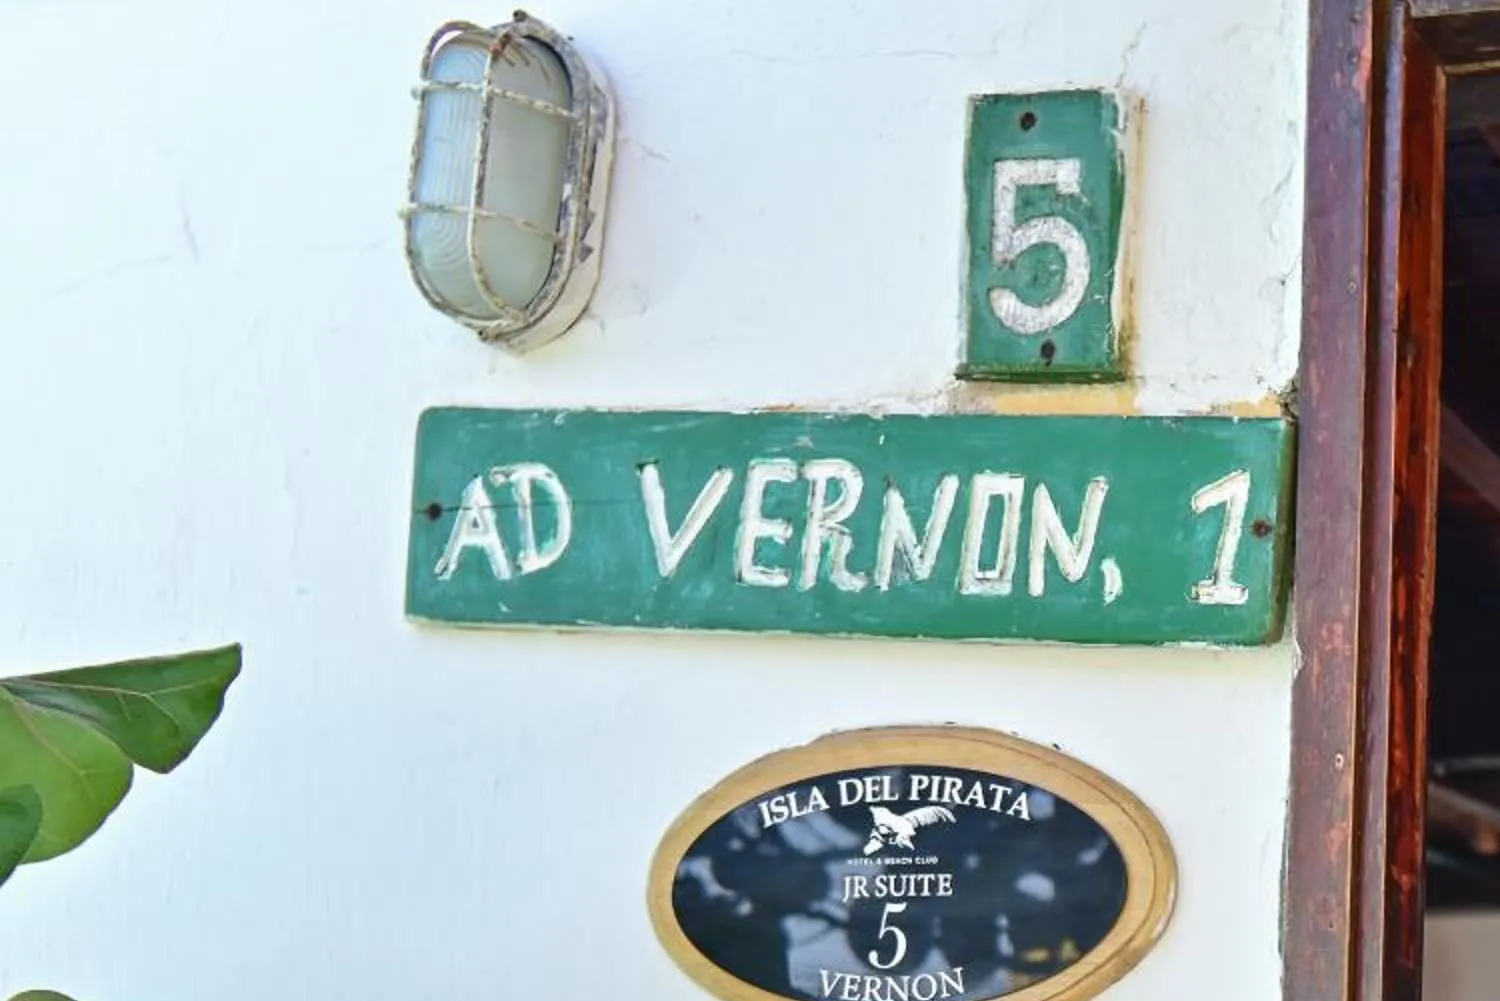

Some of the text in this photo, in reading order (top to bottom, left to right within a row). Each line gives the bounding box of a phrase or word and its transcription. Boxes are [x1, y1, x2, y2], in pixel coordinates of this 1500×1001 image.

[989, 157, 1091, 335] 5
[433, 456, 1253, 606] AD VERNON, 1
[758, 774, 1031, 829] ISLA DEL PIRATA
[842, 873, 954, 903] JR SUITE
[868, 901, 908, 970] 5
